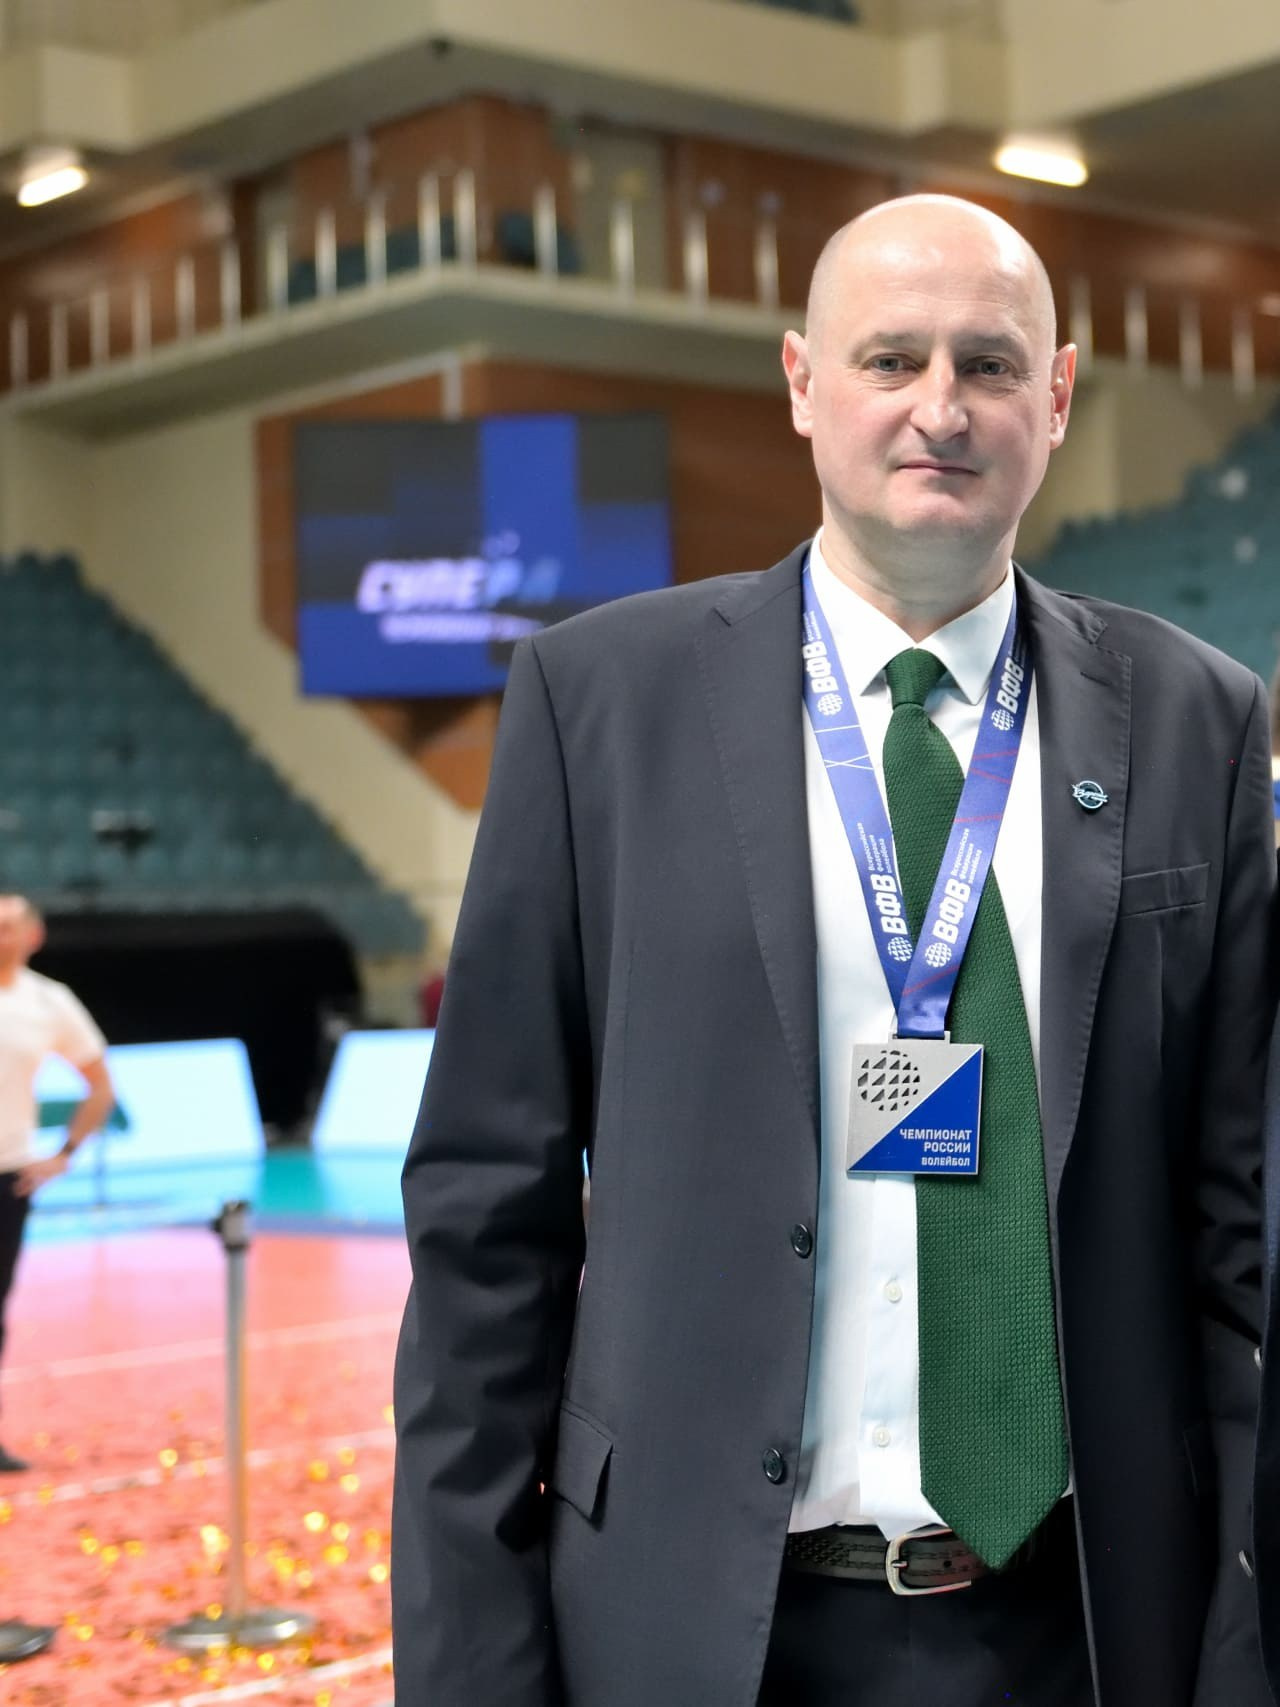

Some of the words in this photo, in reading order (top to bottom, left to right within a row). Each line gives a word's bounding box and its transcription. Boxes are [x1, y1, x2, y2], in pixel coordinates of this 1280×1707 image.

[802, 641, 839, 693] ВФВ
[997, 657, 1024, 714] ВФВ
[870, 874, 908, 935] ВФВ
[932, 878, 971, 944] ВФВ
[899, 1128, 973, 1141] ЧЕМПИОНАТ
[923, 1141, 971, 1153] РОССИИ
[921, 1155, 970, 1167] ВОЛЕЙБОЛ
